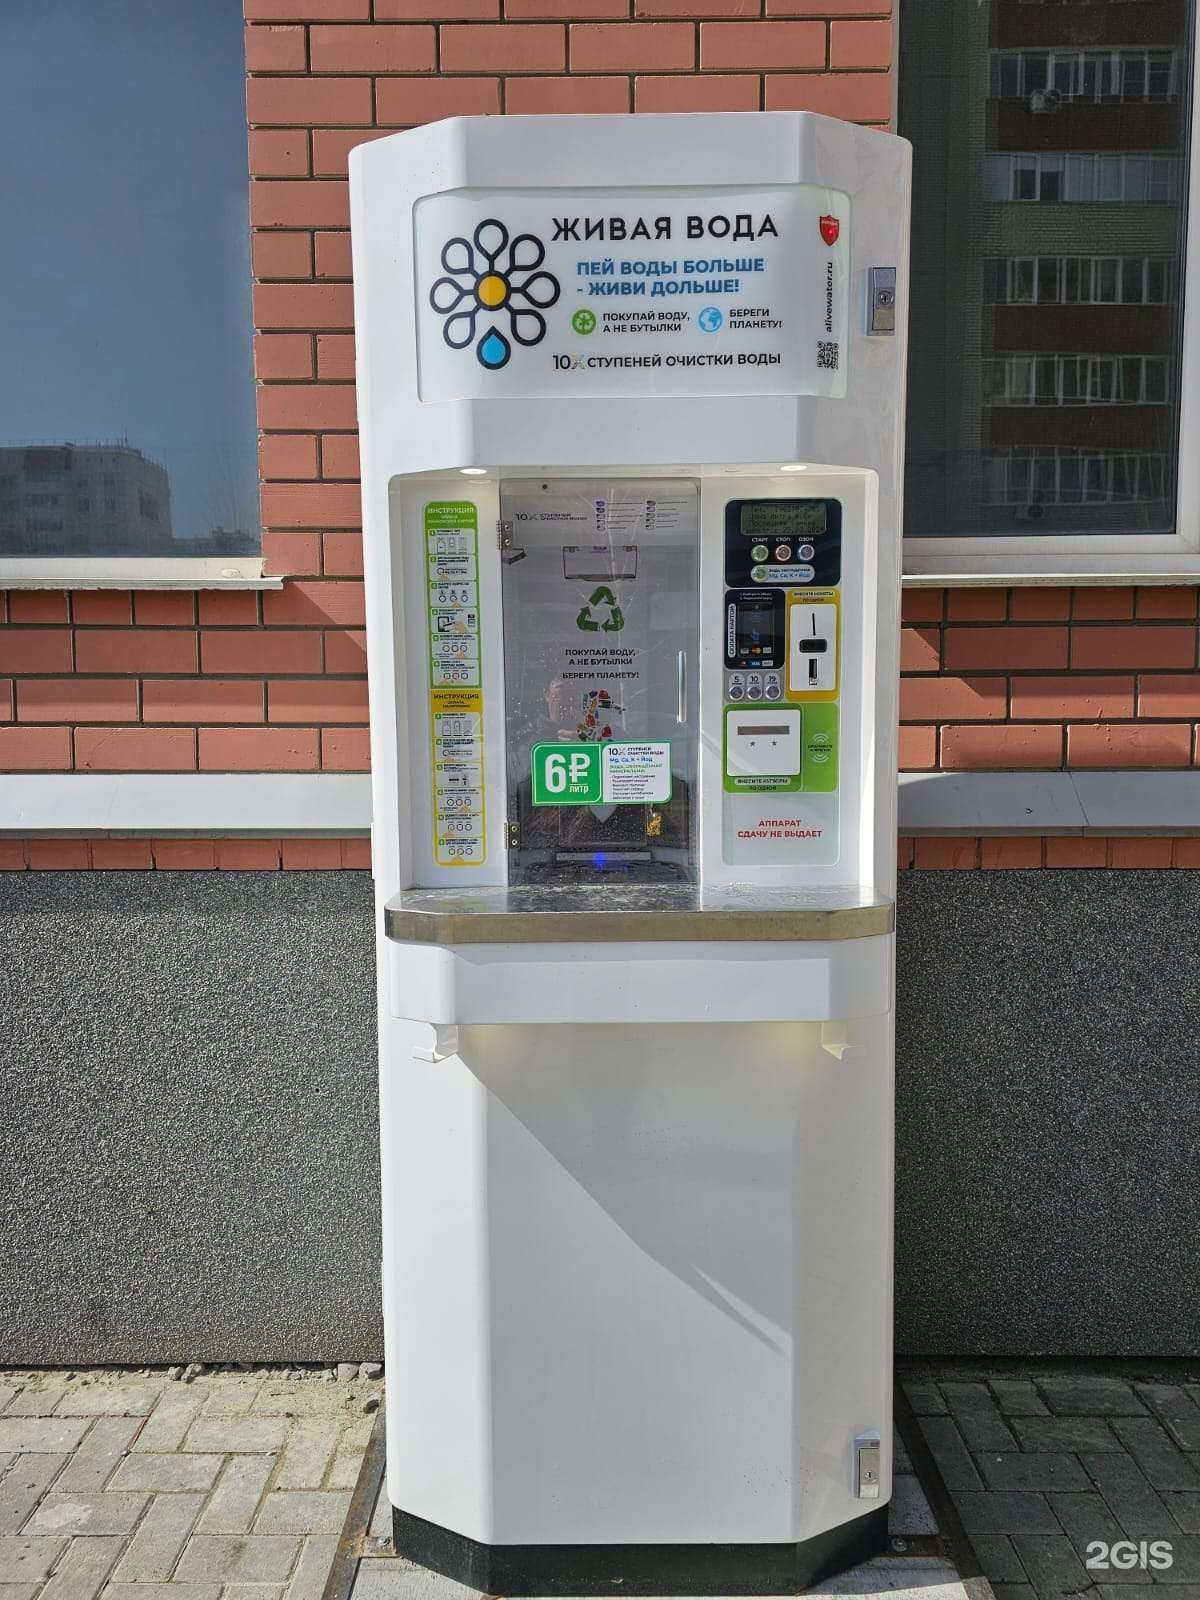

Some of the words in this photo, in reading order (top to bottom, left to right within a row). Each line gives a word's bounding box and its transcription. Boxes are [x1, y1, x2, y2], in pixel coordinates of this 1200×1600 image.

[551, 216, 671, 241] ЖИВАЯ
[686, 214, 779, 242] ВОДА
[577, 257, 614, 275] ПЕЙ
[620, 260, 677, 277] ВОДЫ
[683, 257, 764, 274] БОЛЬШЕ
[588, 281, 646, 296] ЖИВИ
[651, 279, 740, 297] ДОЛЬШЕ!
[603, 310, 656, 322] ПОКУПАЙ
[658, 311, 691, 323] ВОДУ,
[729, 308, 770, 318] БЕРЕГИ
[602, 324, 611, 333] А
[613, 324, 628, 333] НЕ
[630, 323, 682, 333] БУТЫЛКИ
[729, 320, 783, 329] ПЛАНЕТУ!
[587, 354, 661, 368] СТУПЕНЕЙ
[665, 354, 734, 367] ОЧИСТКИ
[737, 352, 781, 366] ВОДЫ
[565, 647, 608, 656] ПОКУПАЙ
[609, 648, 636, 657] ВОДУ,
[568, 658, 576, 666] А
[577, 658, 589, 666] НЕ
[562, 671, 595, 679] БЕРЕГИ
[737, 830, 768, 838] СДАЧУ
[770, 830, 783, 838] НЕ
[784, 830, 822, 838] ВЫДАЕТ
